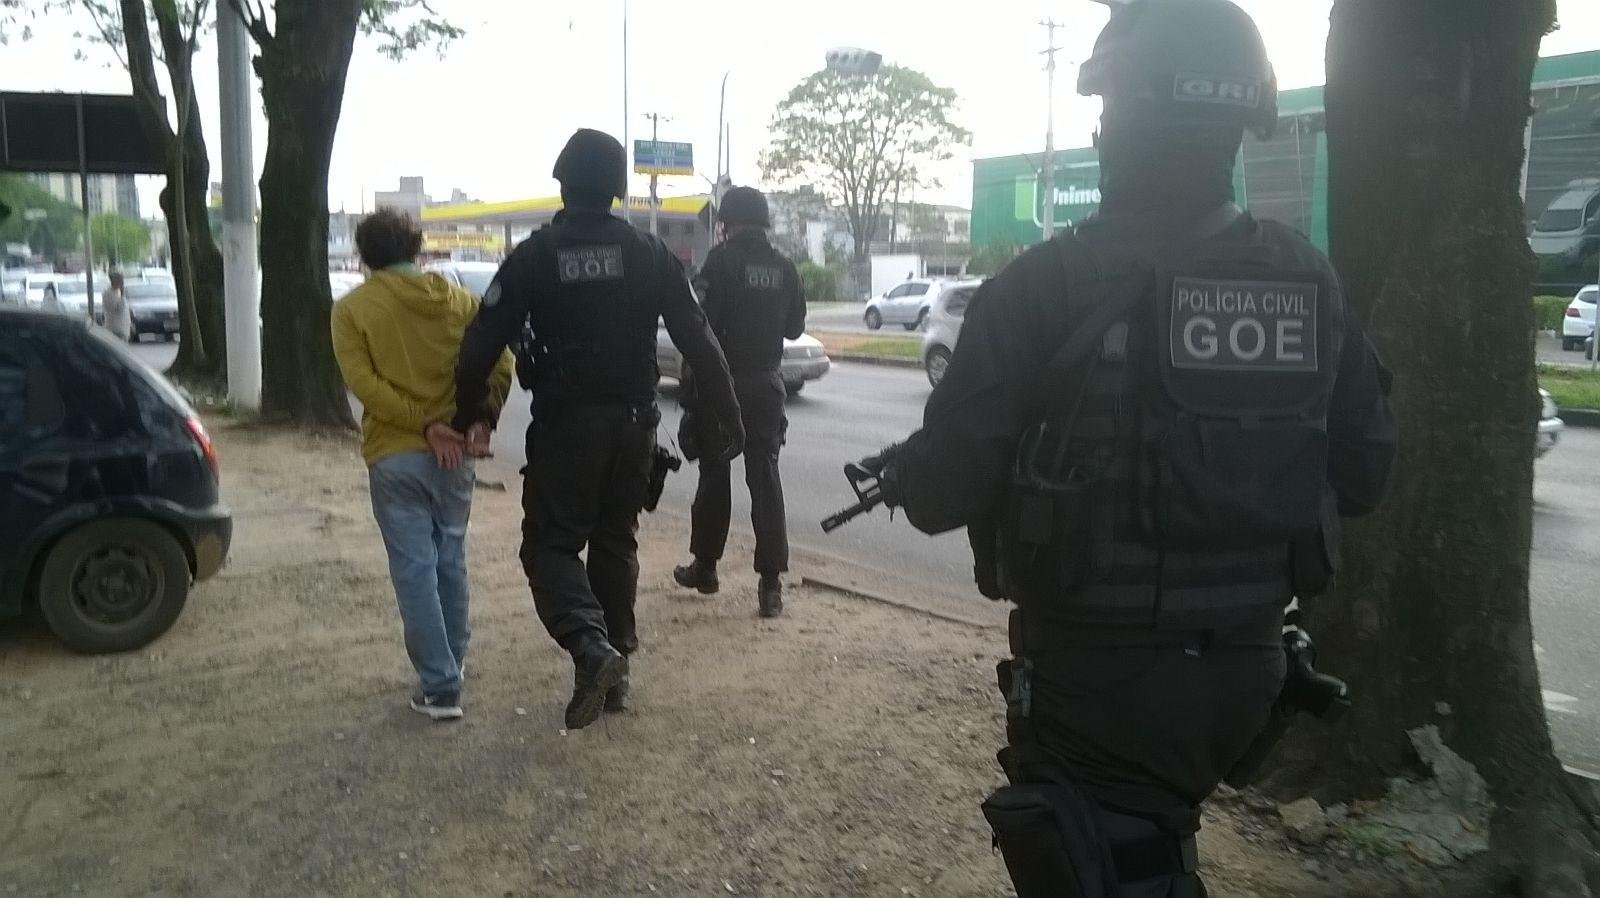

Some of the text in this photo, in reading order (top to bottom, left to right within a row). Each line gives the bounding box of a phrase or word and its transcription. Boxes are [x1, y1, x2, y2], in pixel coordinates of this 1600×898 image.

[565, 257, 618, 280] GOE
[1178, 285, 1309, 316] POLÍCIA CIVIL
[1183, 315, 1304, 361] GOE
